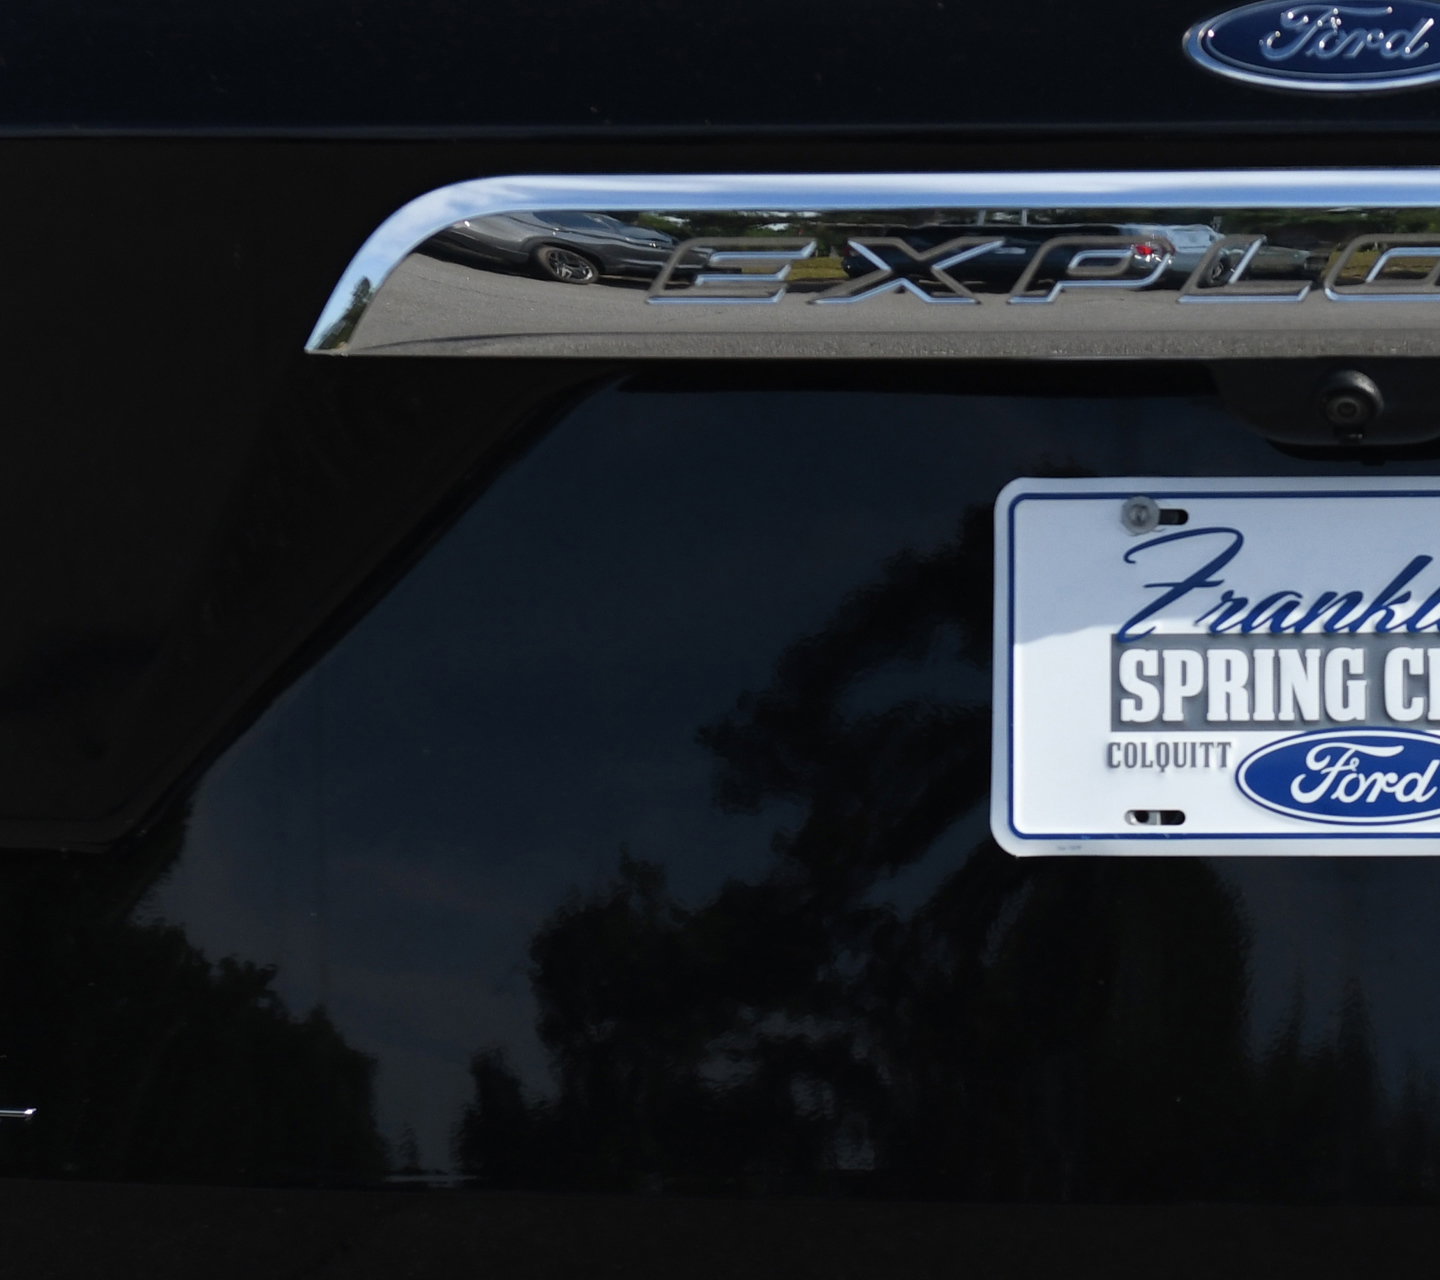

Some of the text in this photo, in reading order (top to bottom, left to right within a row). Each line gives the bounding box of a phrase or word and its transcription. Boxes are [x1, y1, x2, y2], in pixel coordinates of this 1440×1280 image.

[1260, 4, 1434, 61] Ford
[1118, 646, 1368, 723] SPRING
[1107, 741, 1231, 771] COLQUITT
[1290, 742, 1440, 804] Ford
